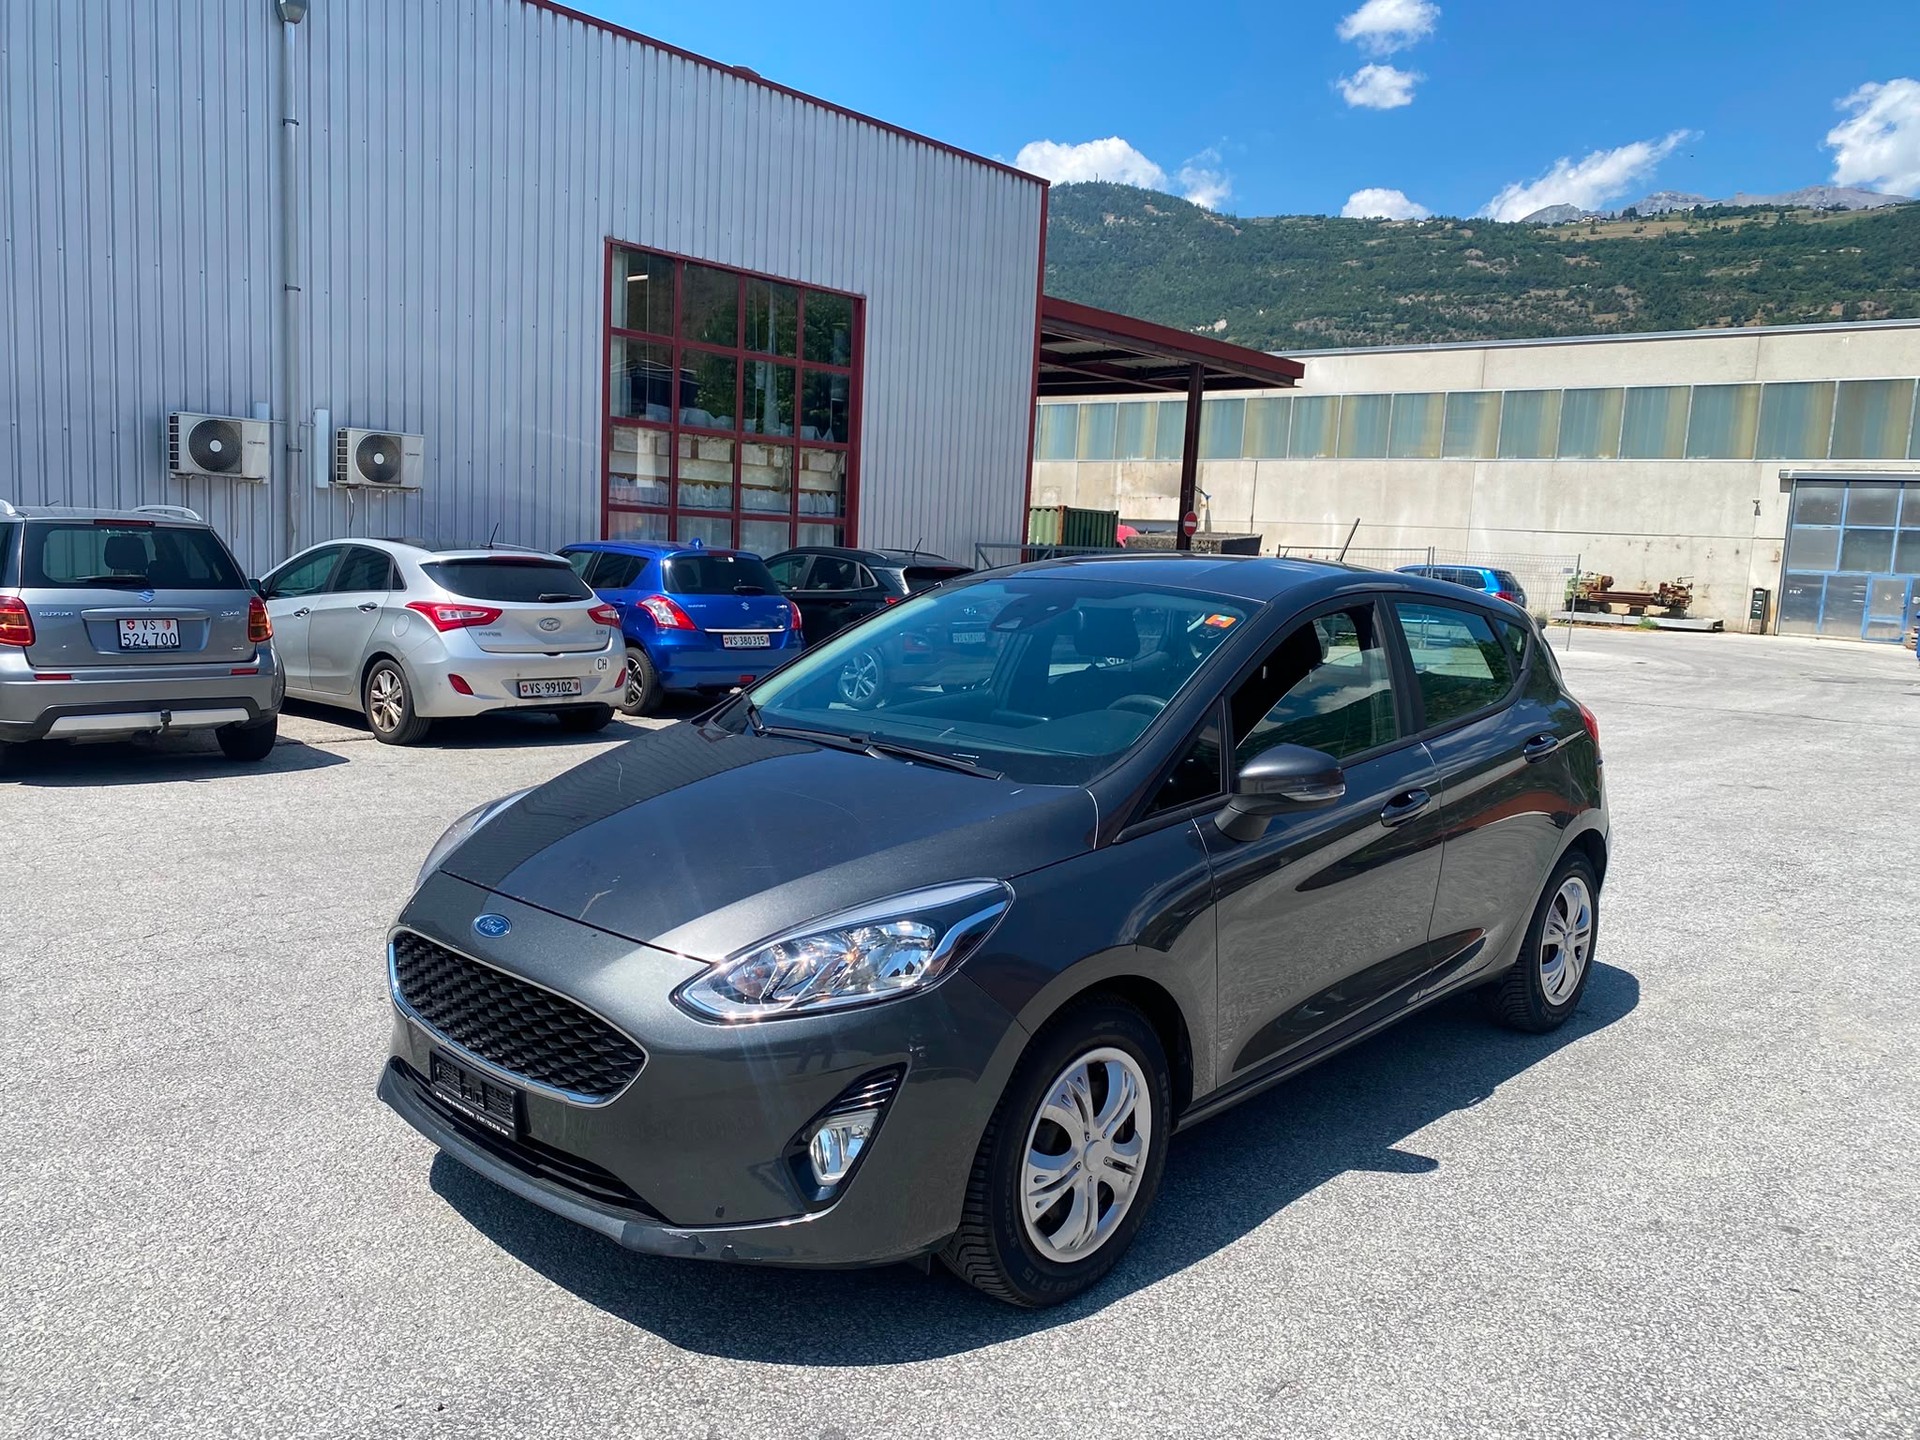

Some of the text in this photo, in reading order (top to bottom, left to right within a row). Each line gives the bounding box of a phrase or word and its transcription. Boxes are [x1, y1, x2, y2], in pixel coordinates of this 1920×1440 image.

[142, 620, 156, 631] VS
[122, 632, 177, 647] 524 700
[597, 658, 608, 670] CH
